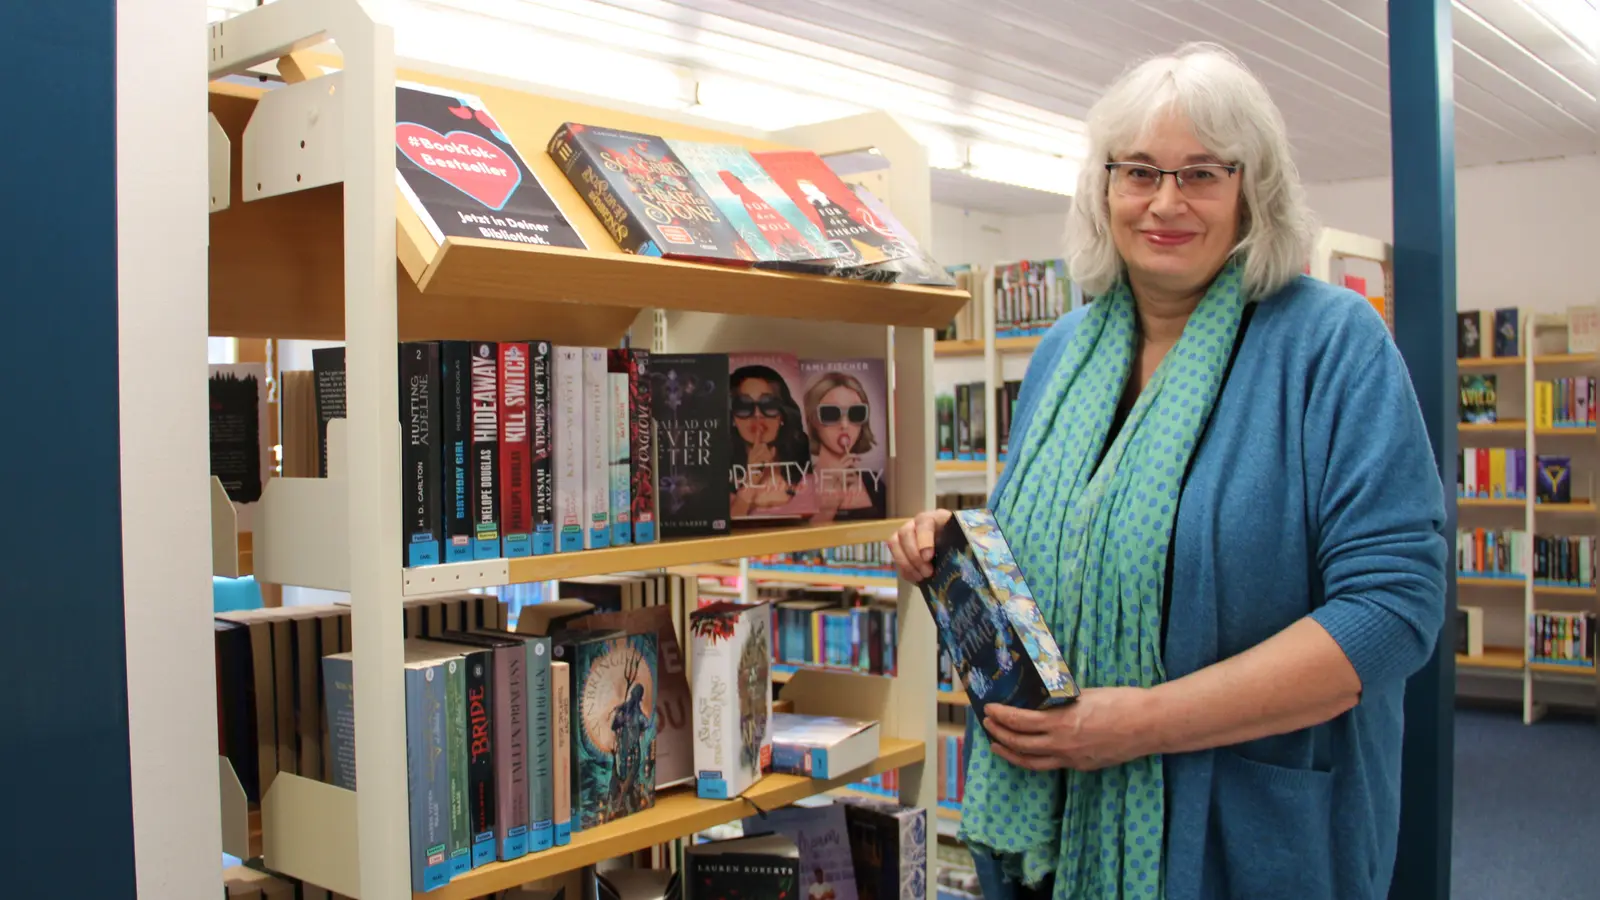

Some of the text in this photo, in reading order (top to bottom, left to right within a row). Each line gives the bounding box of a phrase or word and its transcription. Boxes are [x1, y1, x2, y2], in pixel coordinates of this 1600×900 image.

[408, 136, 498, 160] #BookTok-
[420, 153, 508, 177] Bestseller
[458, 211, 550, 233] Jetzt in Deiner
[637, 192, 721, 225] STONE
[479, 227, 551, 245] Bibliothek.
[757, 222, 792, 232] WOLF
[827, 226, 869, 238] THRON
[416, 350, 422, 360] 2
[534, 356, 545, 379] TEA
[800, 361, 869, 372] TAMI FISCHER
[472, 355, 498, 442] HIDEAWAY
[505, 350, 526, 442] KILL SWITCH
[535, 380, 545, 395] OF
[411, 375, 420, 446] HUNTING
[420, 374, 429, 446] ADELINE
[535, 396, 546, 447] TEMPEST
[455, 440, 465, 519] BIRTHDAY GIRL
[480, 449, 493, 488] DOUGLAS
[814, 467, 884, 494] ETTY
[480, 489, 494, 525] ENELOPE
[537, 468, 545, 513] HAFSAH
[418, 505, 424, 514] D.
[509, 659, 521, 723] PRINCESS
[535, 668, 546, 708] REIGN
[469, 685, 491, 760] BRIDE
[511, 727, 522, 784] FALLEN
[536, 710, 547, 778] HAUNTED
[697, 864, 794, 875] LAUREN ROBERTS
